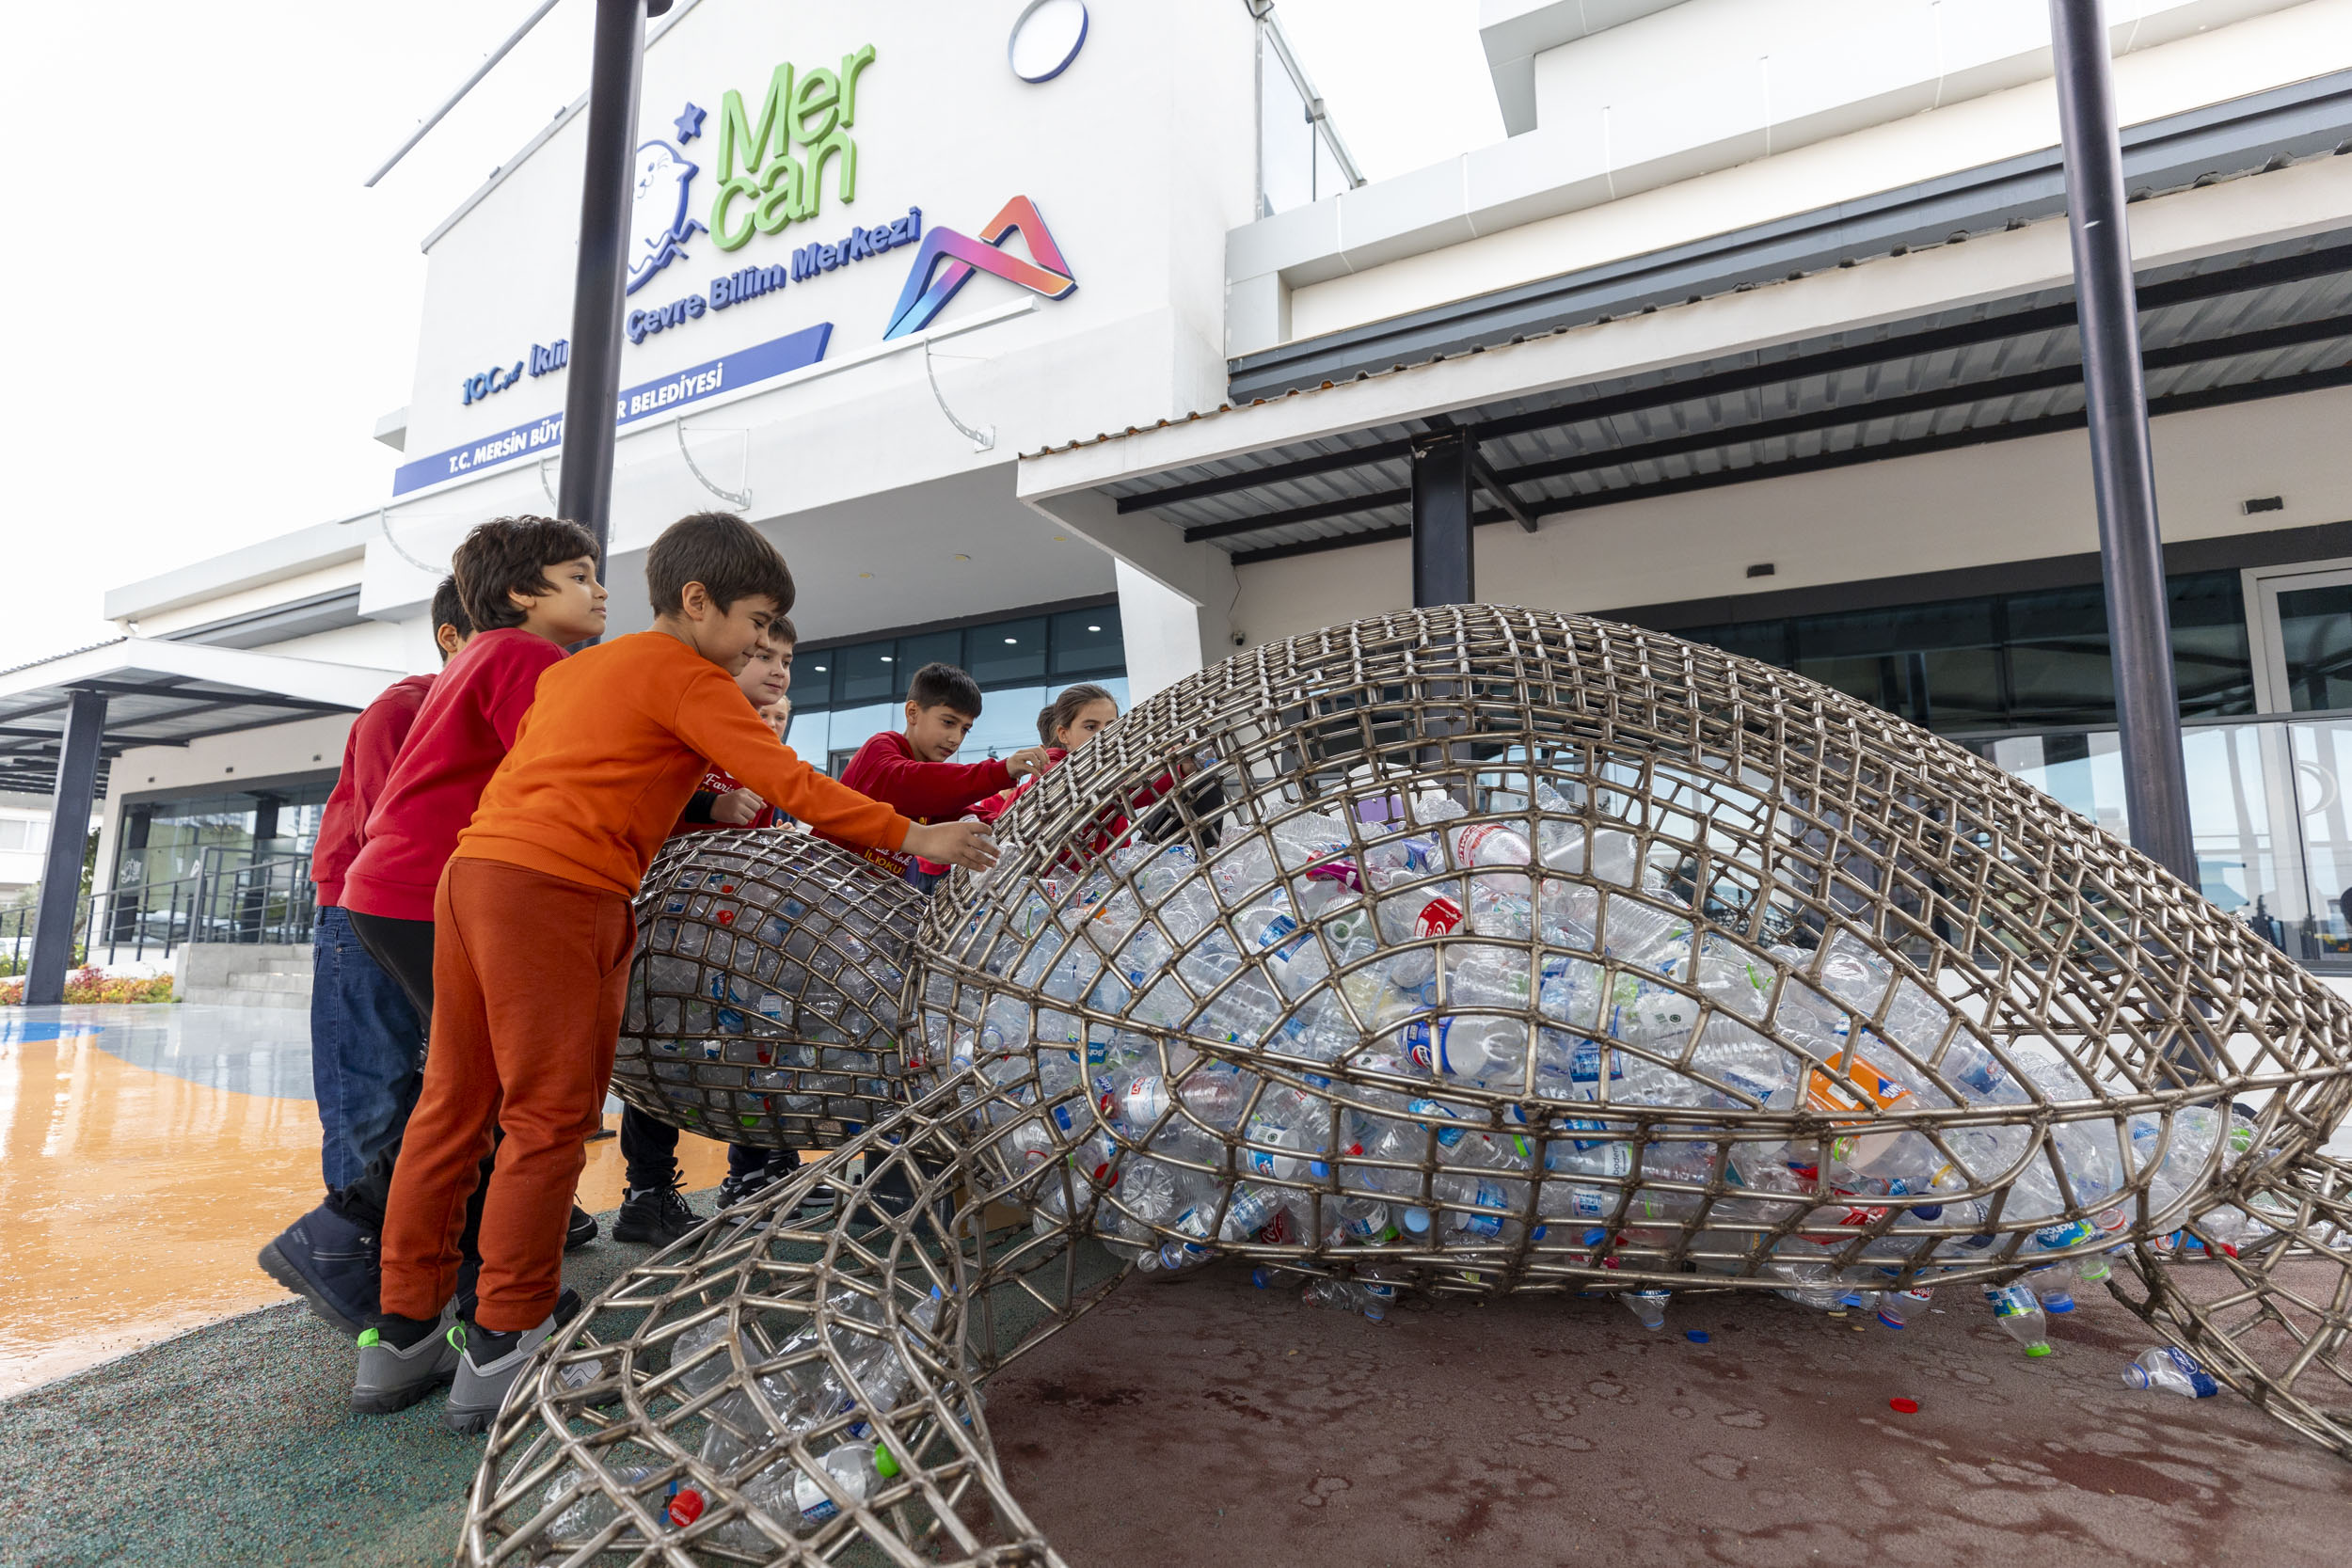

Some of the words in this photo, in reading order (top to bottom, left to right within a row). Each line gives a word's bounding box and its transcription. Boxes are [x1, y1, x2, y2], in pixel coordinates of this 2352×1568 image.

[717, 43, 876, 186] Mer
[710, 131, 857, 253] can
[529, 339, 569, 377] İkli
[627, 293, 706, 345] Çevre
[709, 263, 787, 310] Bilim
[791, 205, 922, 282] Merkezi
[449, 453, 471, 473] T.C.
[473, 432, 528, 466] MERSİN
[630, 362, 723, 416] BELEDİYESİ
